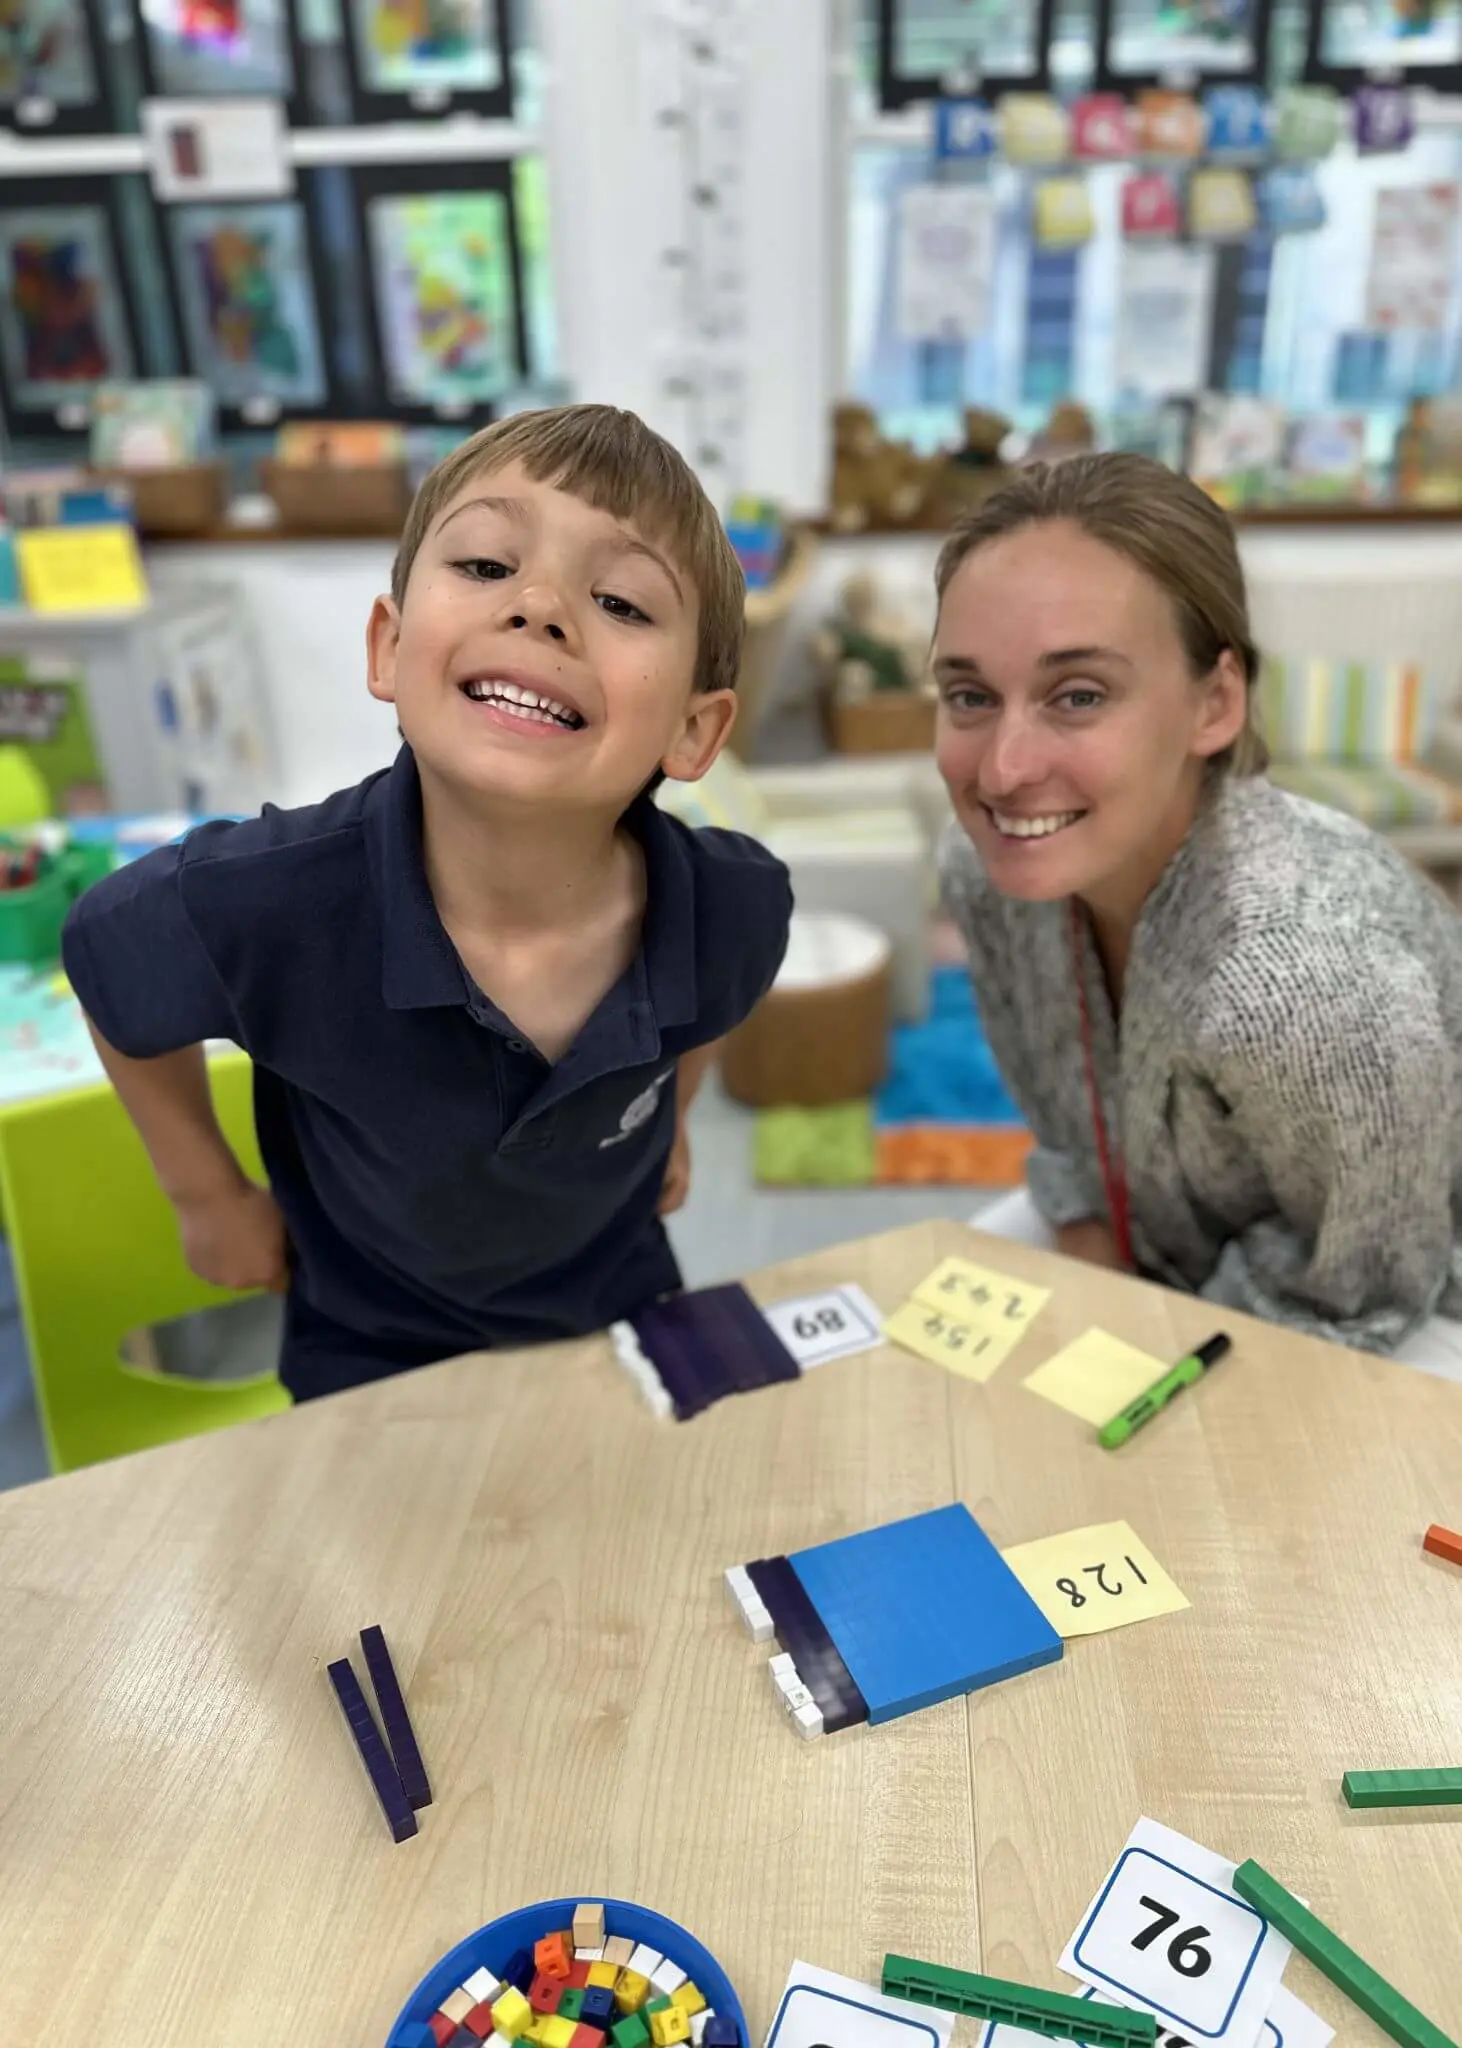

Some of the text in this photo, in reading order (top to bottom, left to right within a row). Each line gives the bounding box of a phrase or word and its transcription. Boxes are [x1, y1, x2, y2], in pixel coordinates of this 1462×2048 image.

[793, 1308, 846, 1340] 89
[1056, 1555, 1147, 1608] 128
[1131, 1895, 1212, 1978] 76
